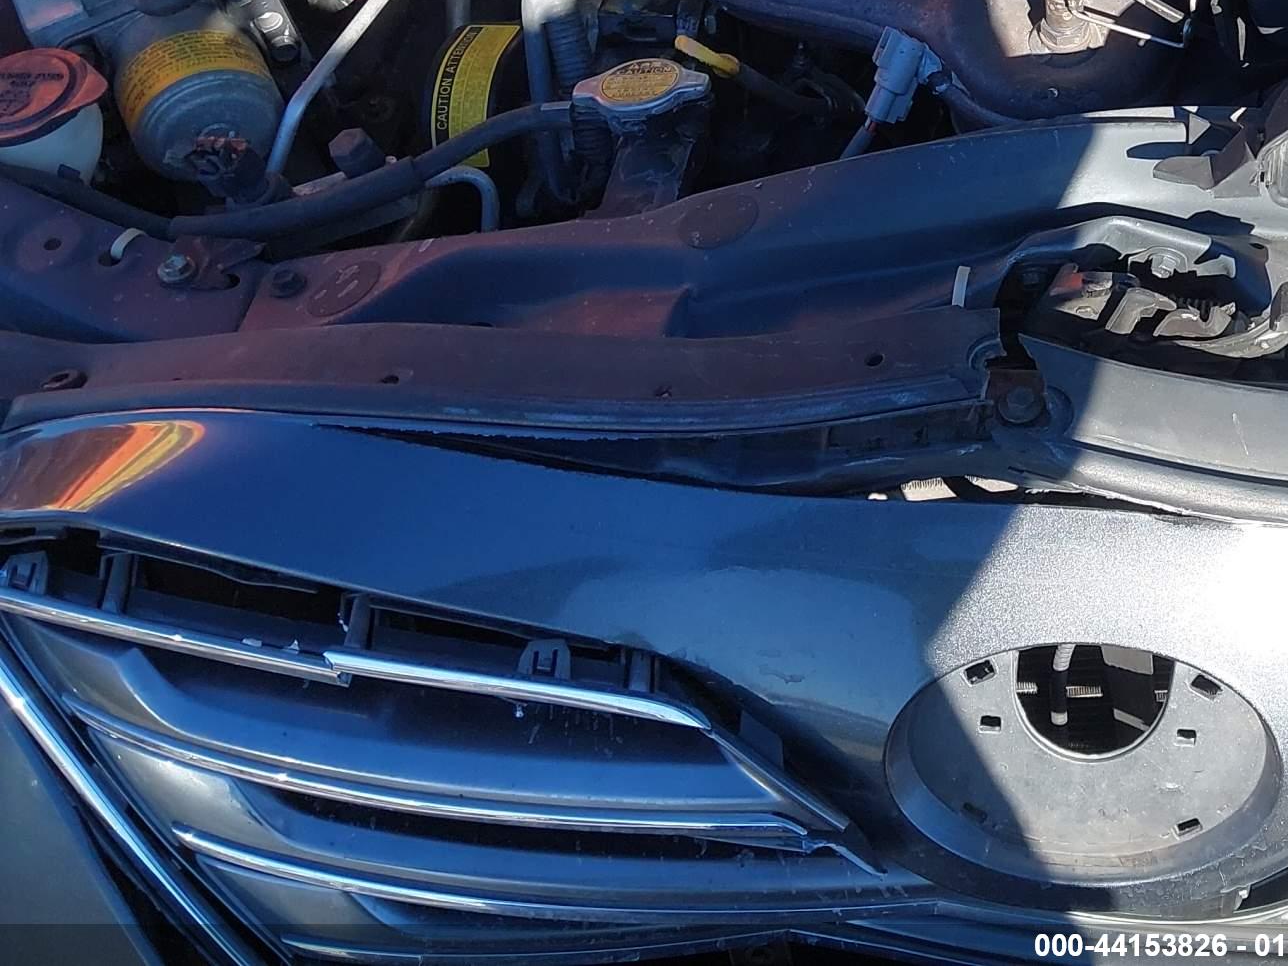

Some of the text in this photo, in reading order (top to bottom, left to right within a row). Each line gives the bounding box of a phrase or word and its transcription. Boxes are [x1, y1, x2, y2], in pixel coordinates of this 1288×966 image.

[436, 78, 453, 131] CAUTION
[448, 32, 478, 74] ATTENTION
[616, 66, 672, 75] CAUTION
